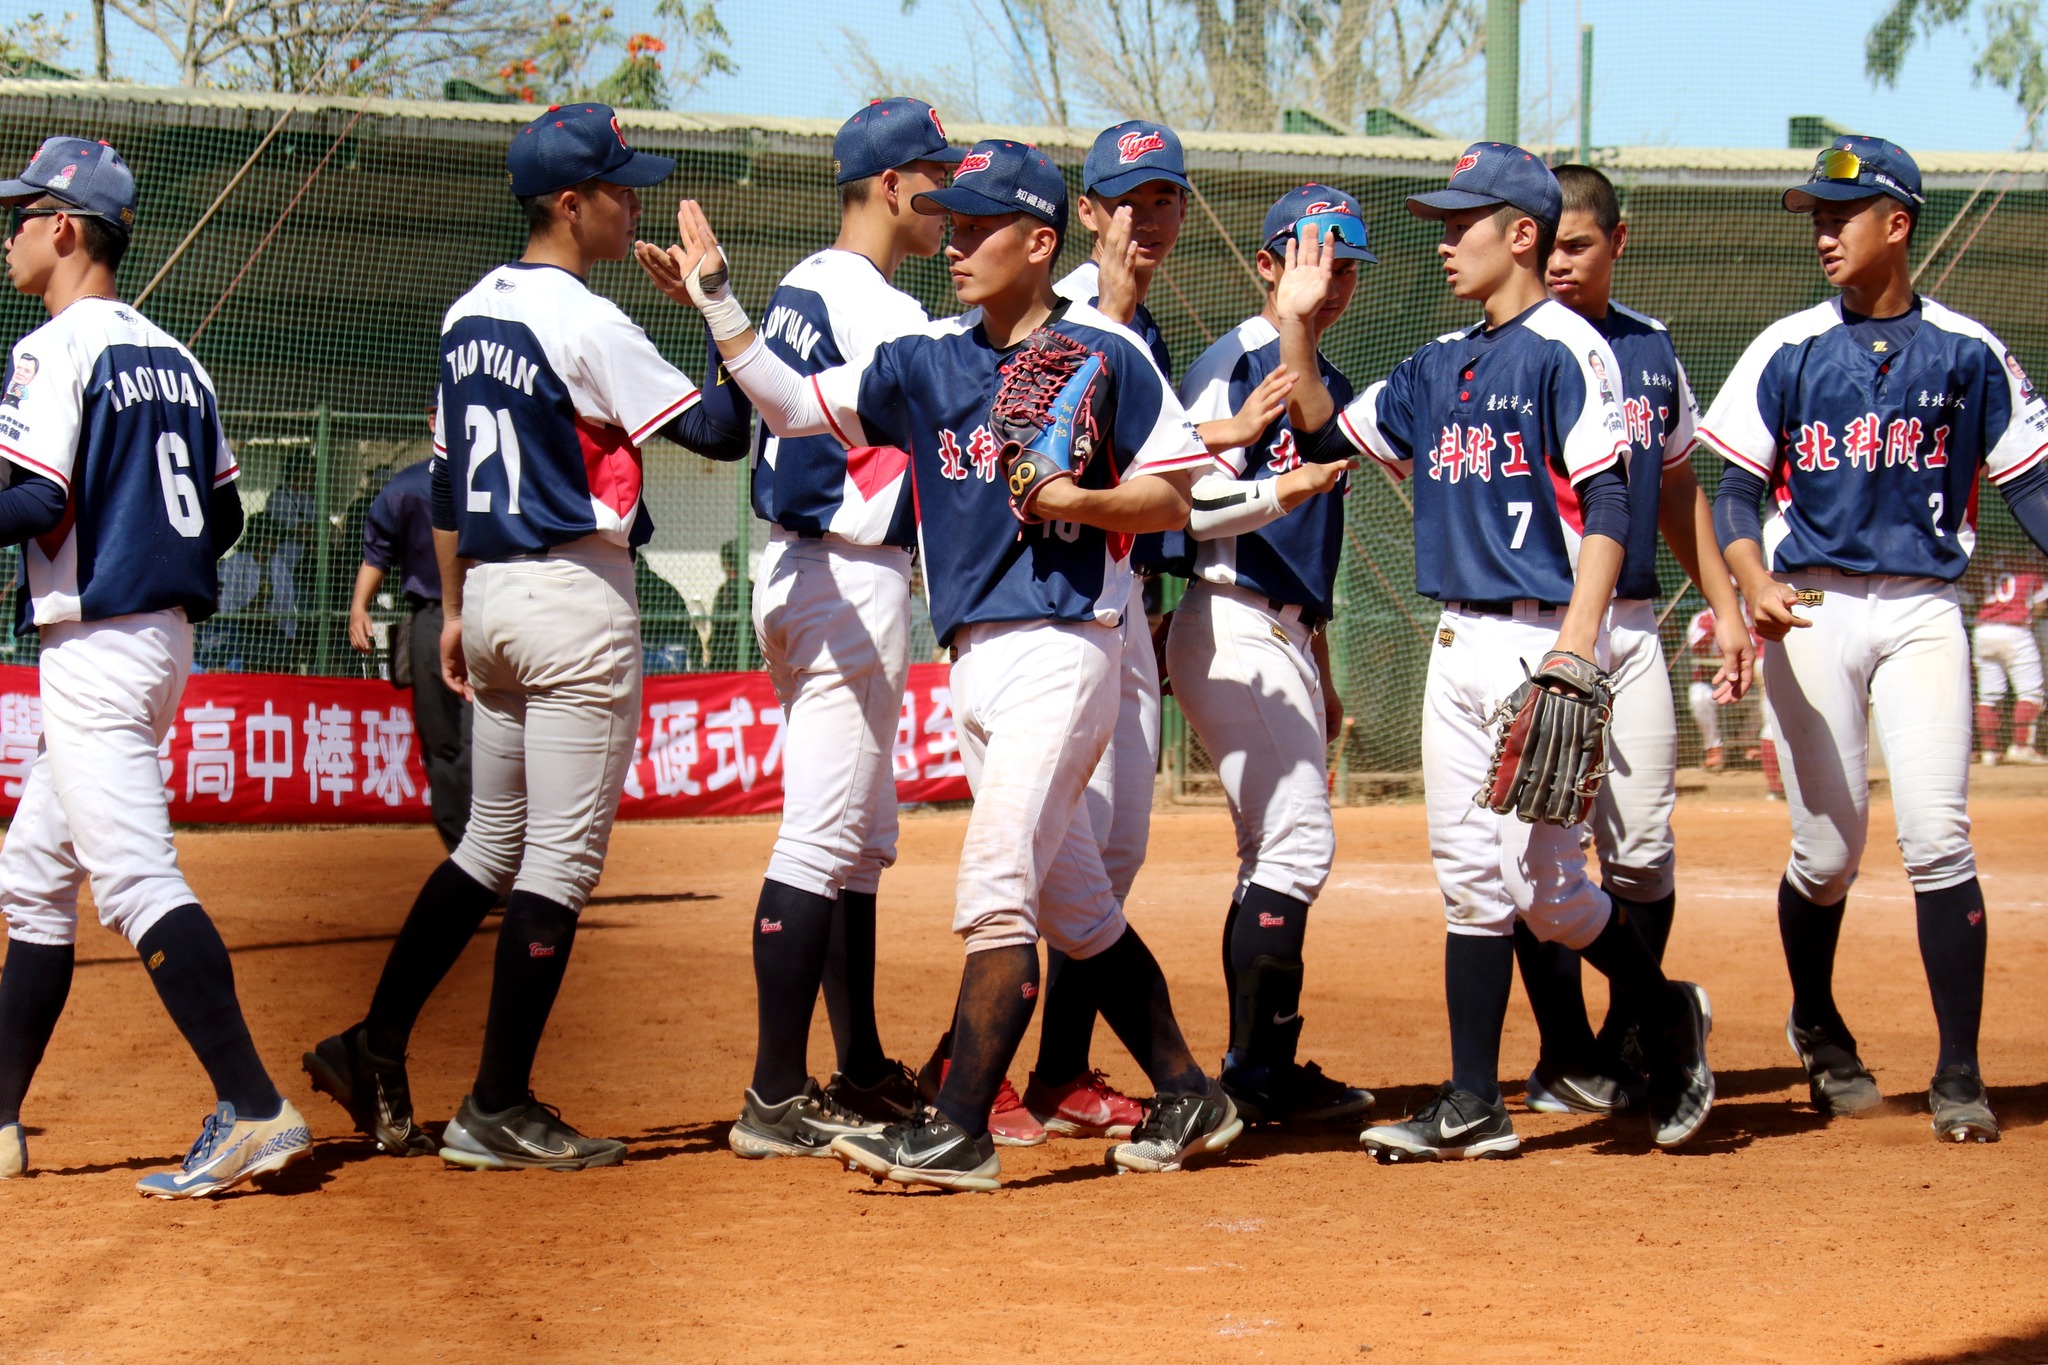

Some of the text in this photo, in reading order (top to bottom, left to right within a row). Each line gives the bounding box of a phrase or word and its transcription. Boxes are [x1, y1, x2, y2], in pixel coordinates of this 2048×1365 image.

[465, 405, 521, 514] 21
[1795, 412, 1951, 473] 北科附工
[155, 431, 205, 538] 6
[1507, 501, 1533, 549] 7
[1928, 492, 1945, 537] 2
[167, 700, 432, 806] 高中棒球
